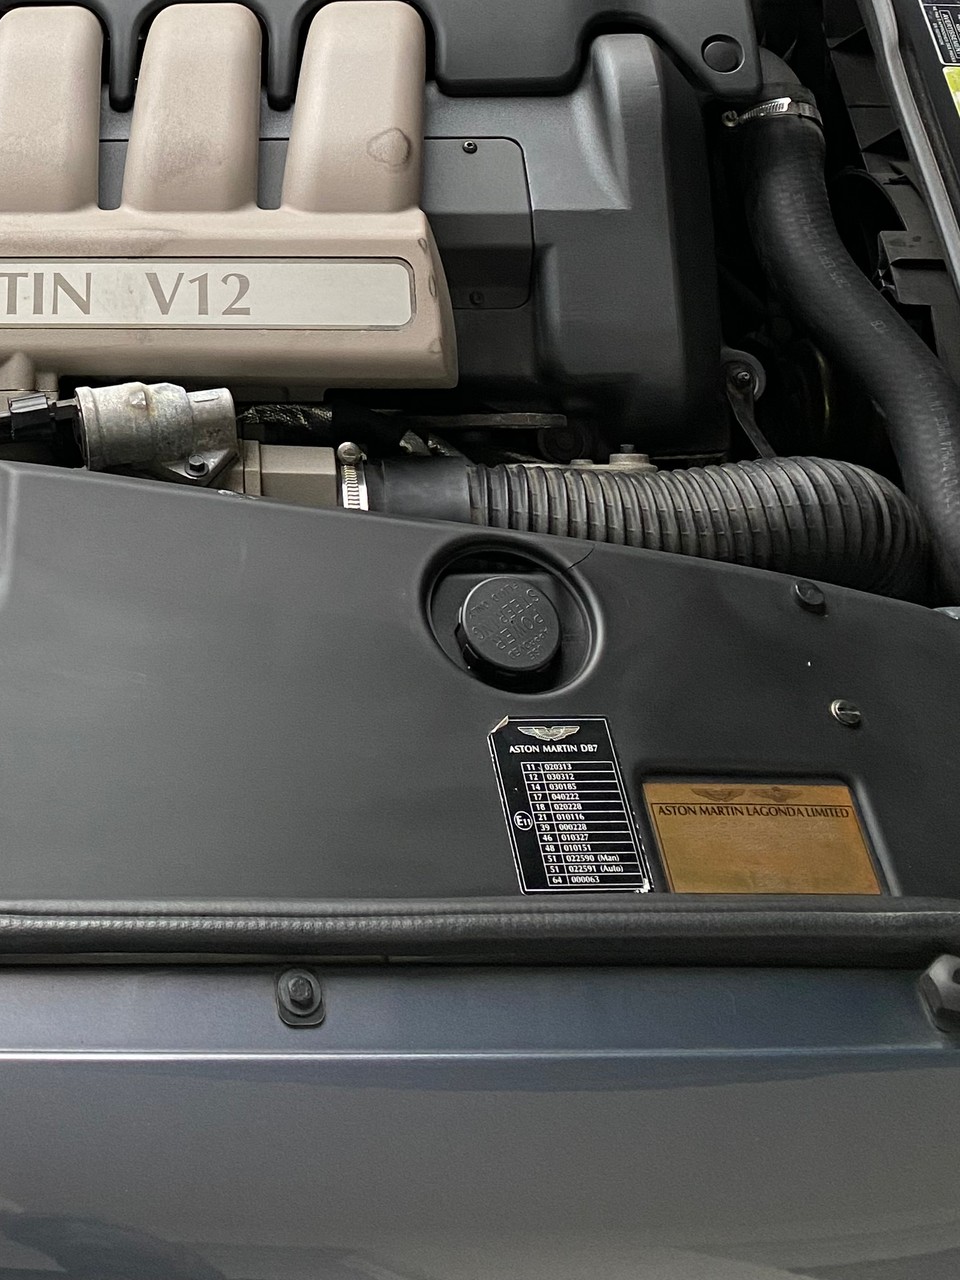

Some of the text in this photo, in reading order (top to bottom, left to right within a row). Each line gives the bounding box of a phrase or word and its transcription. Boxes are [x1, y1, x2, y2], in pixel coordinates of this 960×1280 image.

[144, 272, 252, 316] V12
[472, 590, 539, 640] STEERING
[491, 609, 544, 650] POWER
[509, 744, 598, 753] ASTON MARTIN DB7
[658, 805, 850, 818] ASTON MARTIN LAGONDA LIMITED
[545, 844, 555, 852] 48
[566, 854, 595, 862] 022590
[598, 854, 620, 862] (Man)
[550, 865, 559, 873] 51
[600, 864, 624, 873] (Auto)
